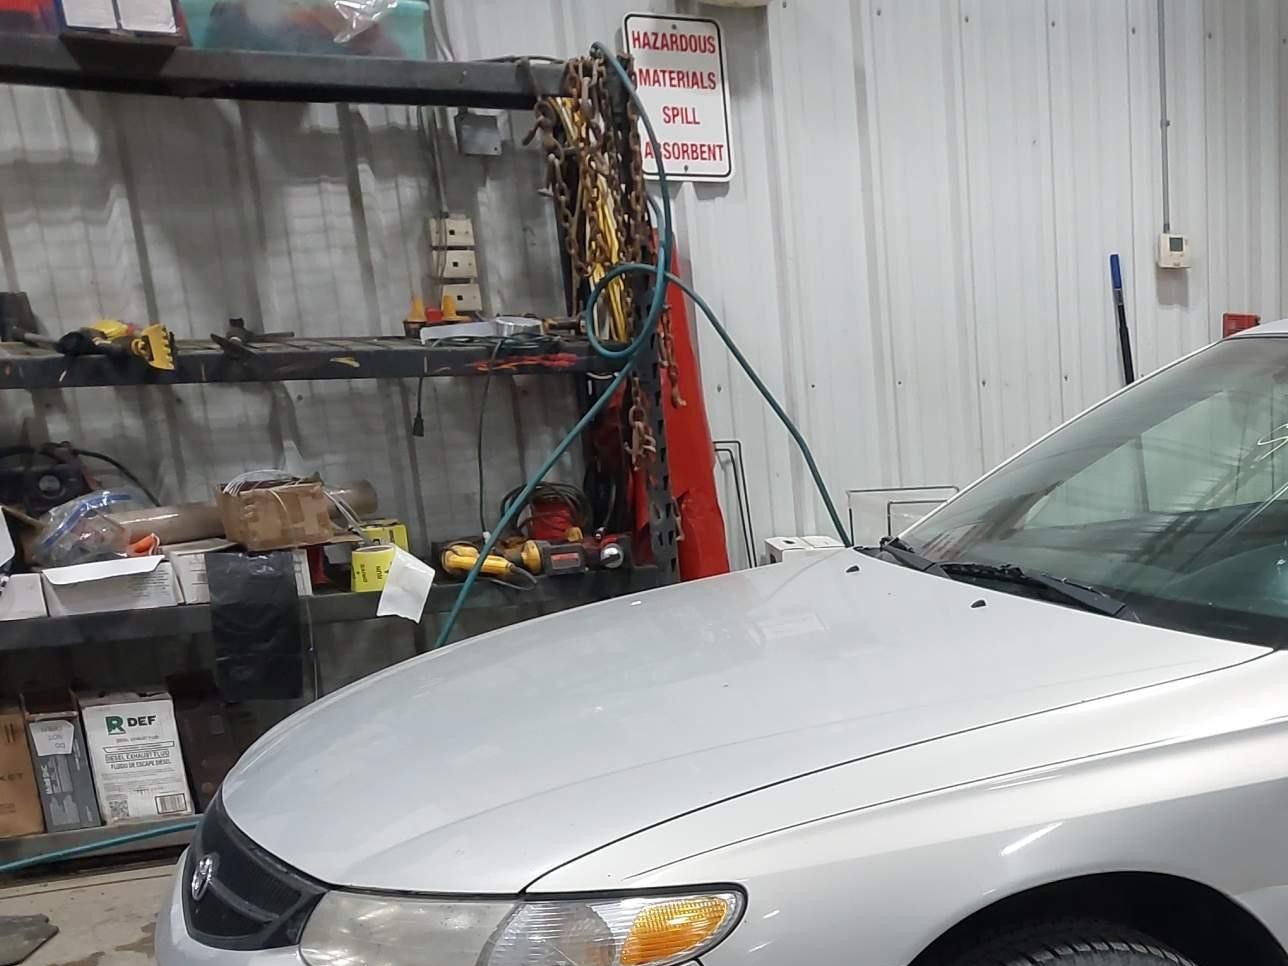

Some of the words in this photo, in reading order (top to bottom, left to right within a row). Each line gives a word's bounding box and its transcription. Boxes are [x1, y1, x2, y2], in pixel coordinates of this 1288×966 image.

[632, 31, 716, 54] HAZARDOUS
[638, 68, 717, 90] MATERIALS
[662, 106, 700, 125] SPILL
[644, 142, 724, 161] ASORBENT
[127, 715, 157, 727] DEF
